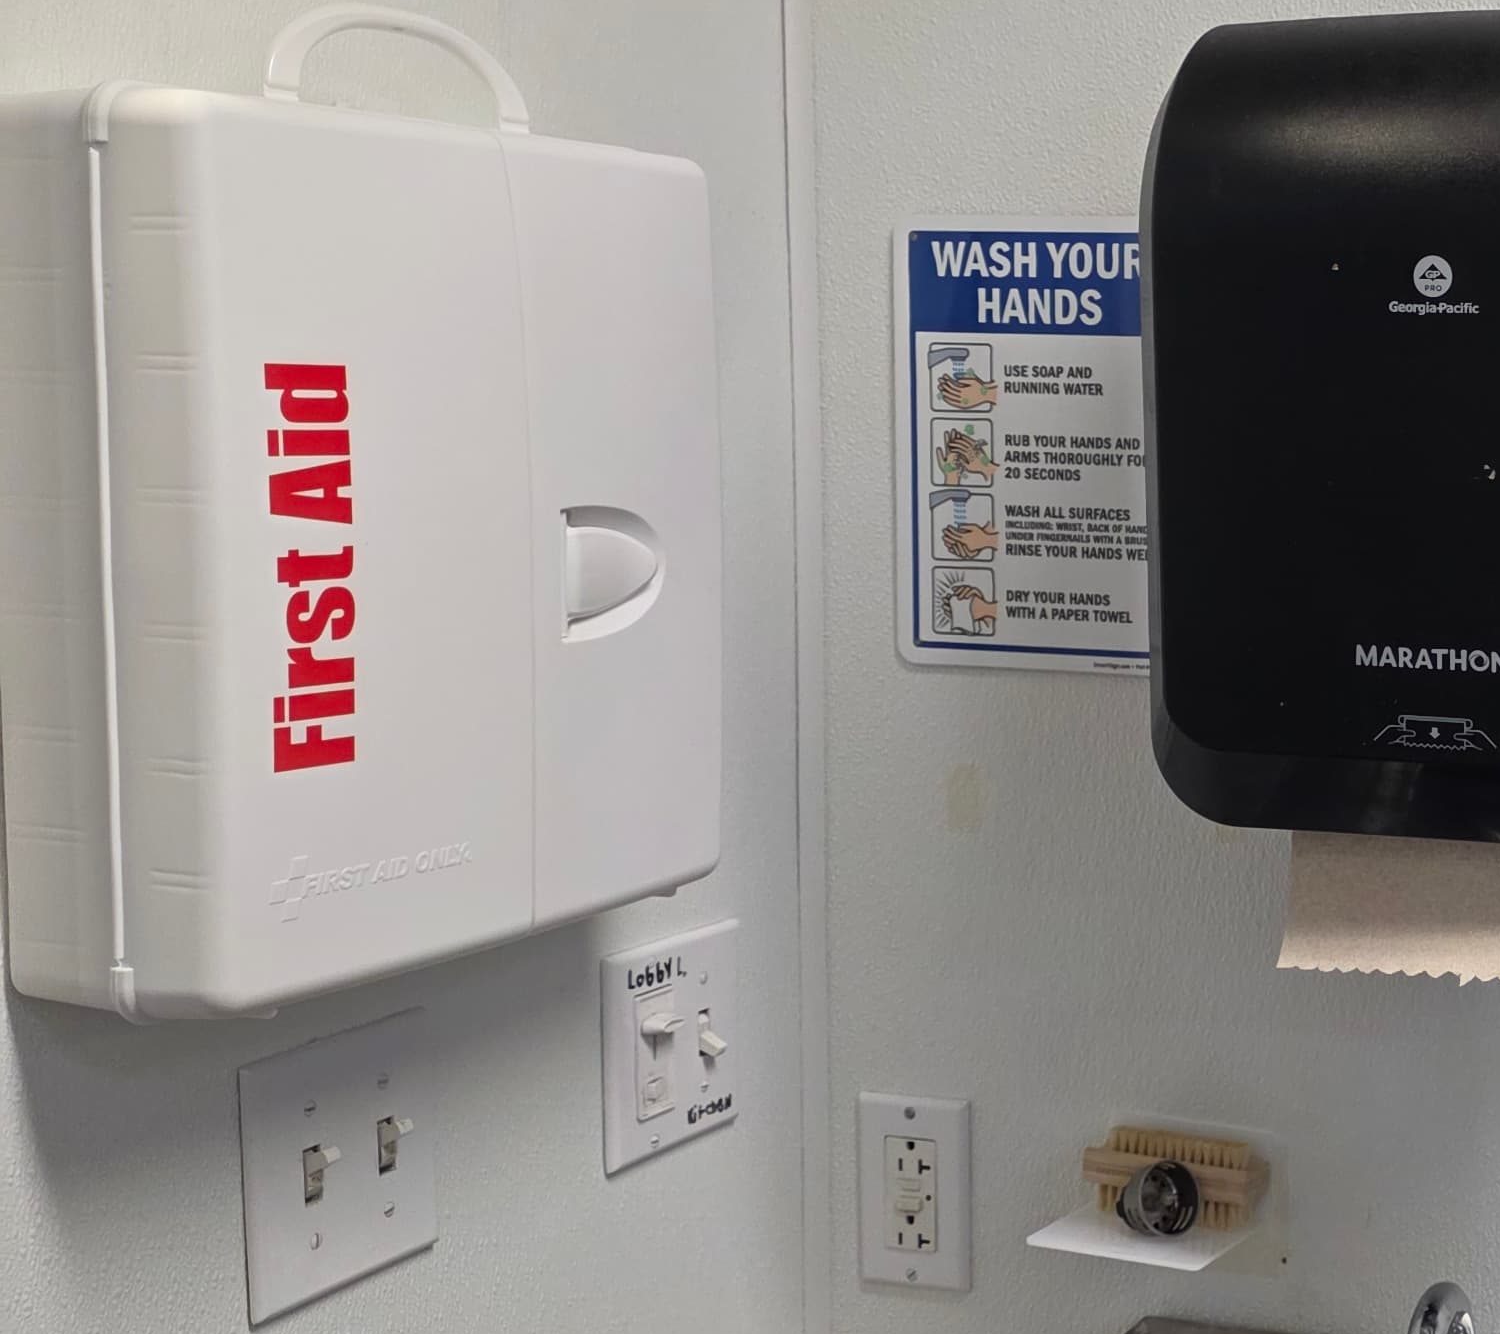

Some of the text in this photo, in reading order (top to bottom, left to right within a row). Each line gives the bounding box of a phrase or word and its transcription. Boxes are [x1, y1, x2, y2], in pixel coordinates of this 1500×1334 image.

[932, 241, 1037, 277] WASH
[977, 288, 1102, 325] HANDS
[1389, 301, 1479, 315] Georgia-Pacific
[1004, 365, 1092, 379] USE SOAP AND
[1004, 381, 1103, 396] RUNNING WATER
[1005, 435, 1140, 450] RUB YOUR HANDS AND
[1004, 451, 1040, 464] ARMS
[1044, 452, 1123, 466] THOROUGHLY
[1004, 467, 1081, 481] 20 SECONDS
[1005, 505, 1130, 521] WASH ALL SURFACES
[1006, 521, 1122, 533] INCLUDING: WRIST, BACK OF
[1006, 532, 1121, 544] UNDER FINGERNAILS WITH A
[1006, 544, 1042, 556] RINSE
[1044, 545, 1077, 558] YOUR
[1082, 547, 1122, 559] HANDS
[264, 363, 356, 773] First Aid
[1006, 590, 1110, 606] DRY YOUR HANDS
[1006, 606, 1132, 624] WITH A PAPER TOWEL
[304, 864, 369, 899] FIRST
[373, 853, 409, 882] AID
